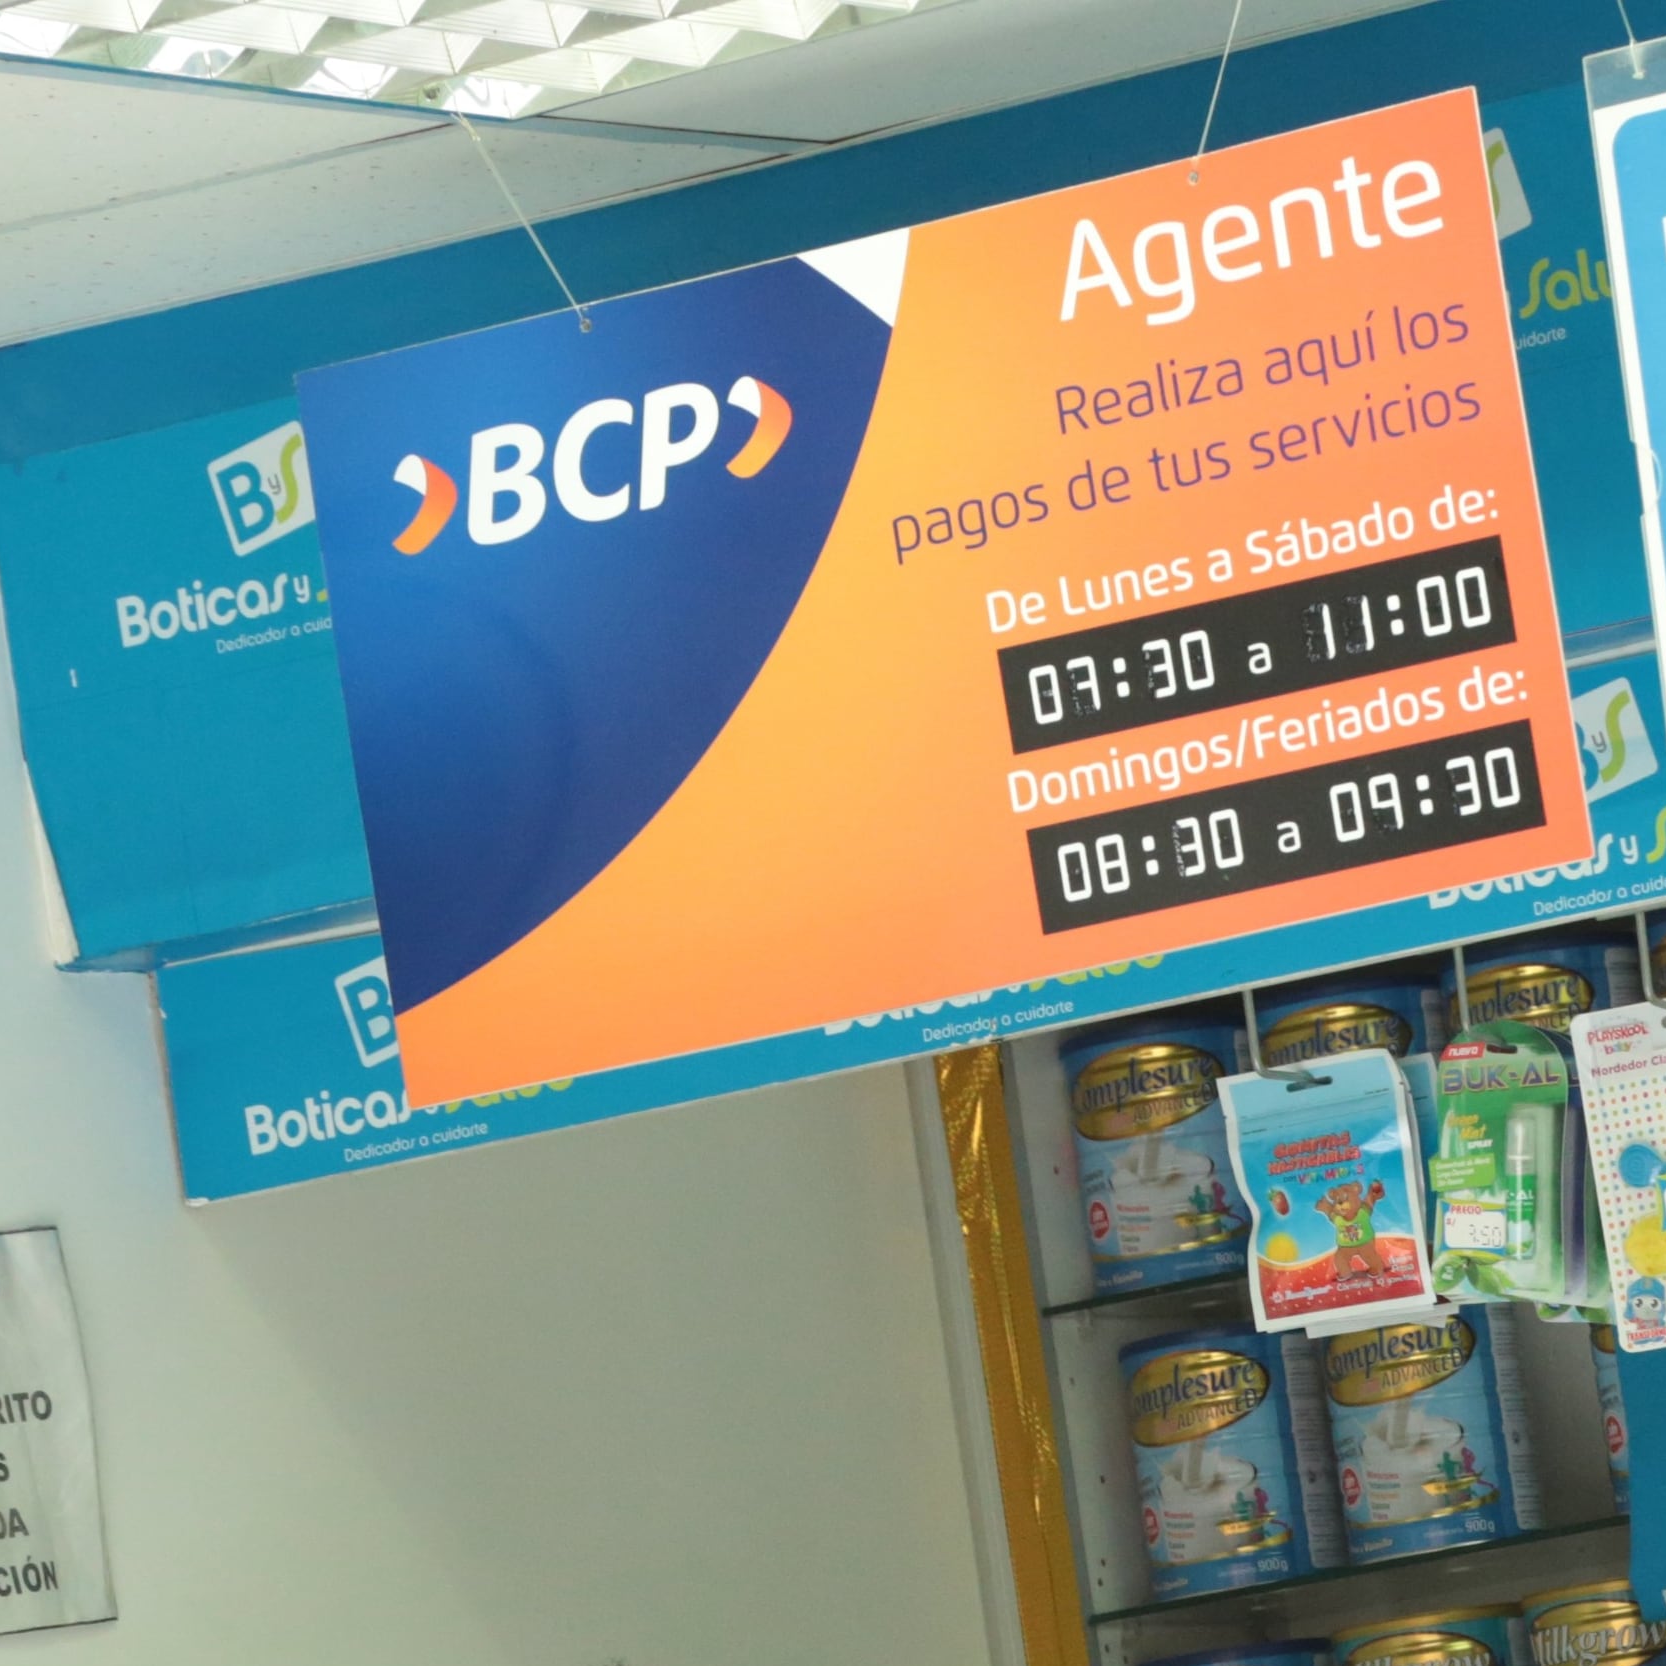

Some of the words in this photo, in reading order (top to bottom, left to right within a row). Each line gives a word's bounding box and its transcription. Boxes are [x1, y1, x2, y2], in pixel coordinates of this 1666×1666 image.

[1059, 156, 1444, 326] Agente
[1054, 355, 1245, 435] Realiza
[1264, 311, 1377, 381] aquí
[1395, 302, 1471, 355] los
[468, 382, 719, 546] BCP
[891, 481, 1050, 565] pagos
[1067, 459, 1132, 512] de
[1147, 439, 1232, 492] tus
[1249, 381, 1482, 470] servicios
[985, 589, 1045, 633] De
[1059, 554, 1193, 619] Lunes
[1207, 548, 1234, 581] a
[1247, 507, 1417, 576] Sábado
[1429, 486, 1500, 542] de:
[1006, 679, 1445, 814] Domingos/Feriados
[1459, 664, 1529, 714] de:
[1028, 629, 1216, 726] 07:30
[1247, 640, 1273, 675] a
[1057, 807, 1244, 903] 08:30
[1276, 819, 1302, 854] a
[1329, 746, 1522, 844] 09:30
[1443, 1060, 1561, 1095] BUK-AL
[1587, 1024, 1649, 1045] PLAYSKOOL
[1591, 1058, 1648, 1078] Mordedor
